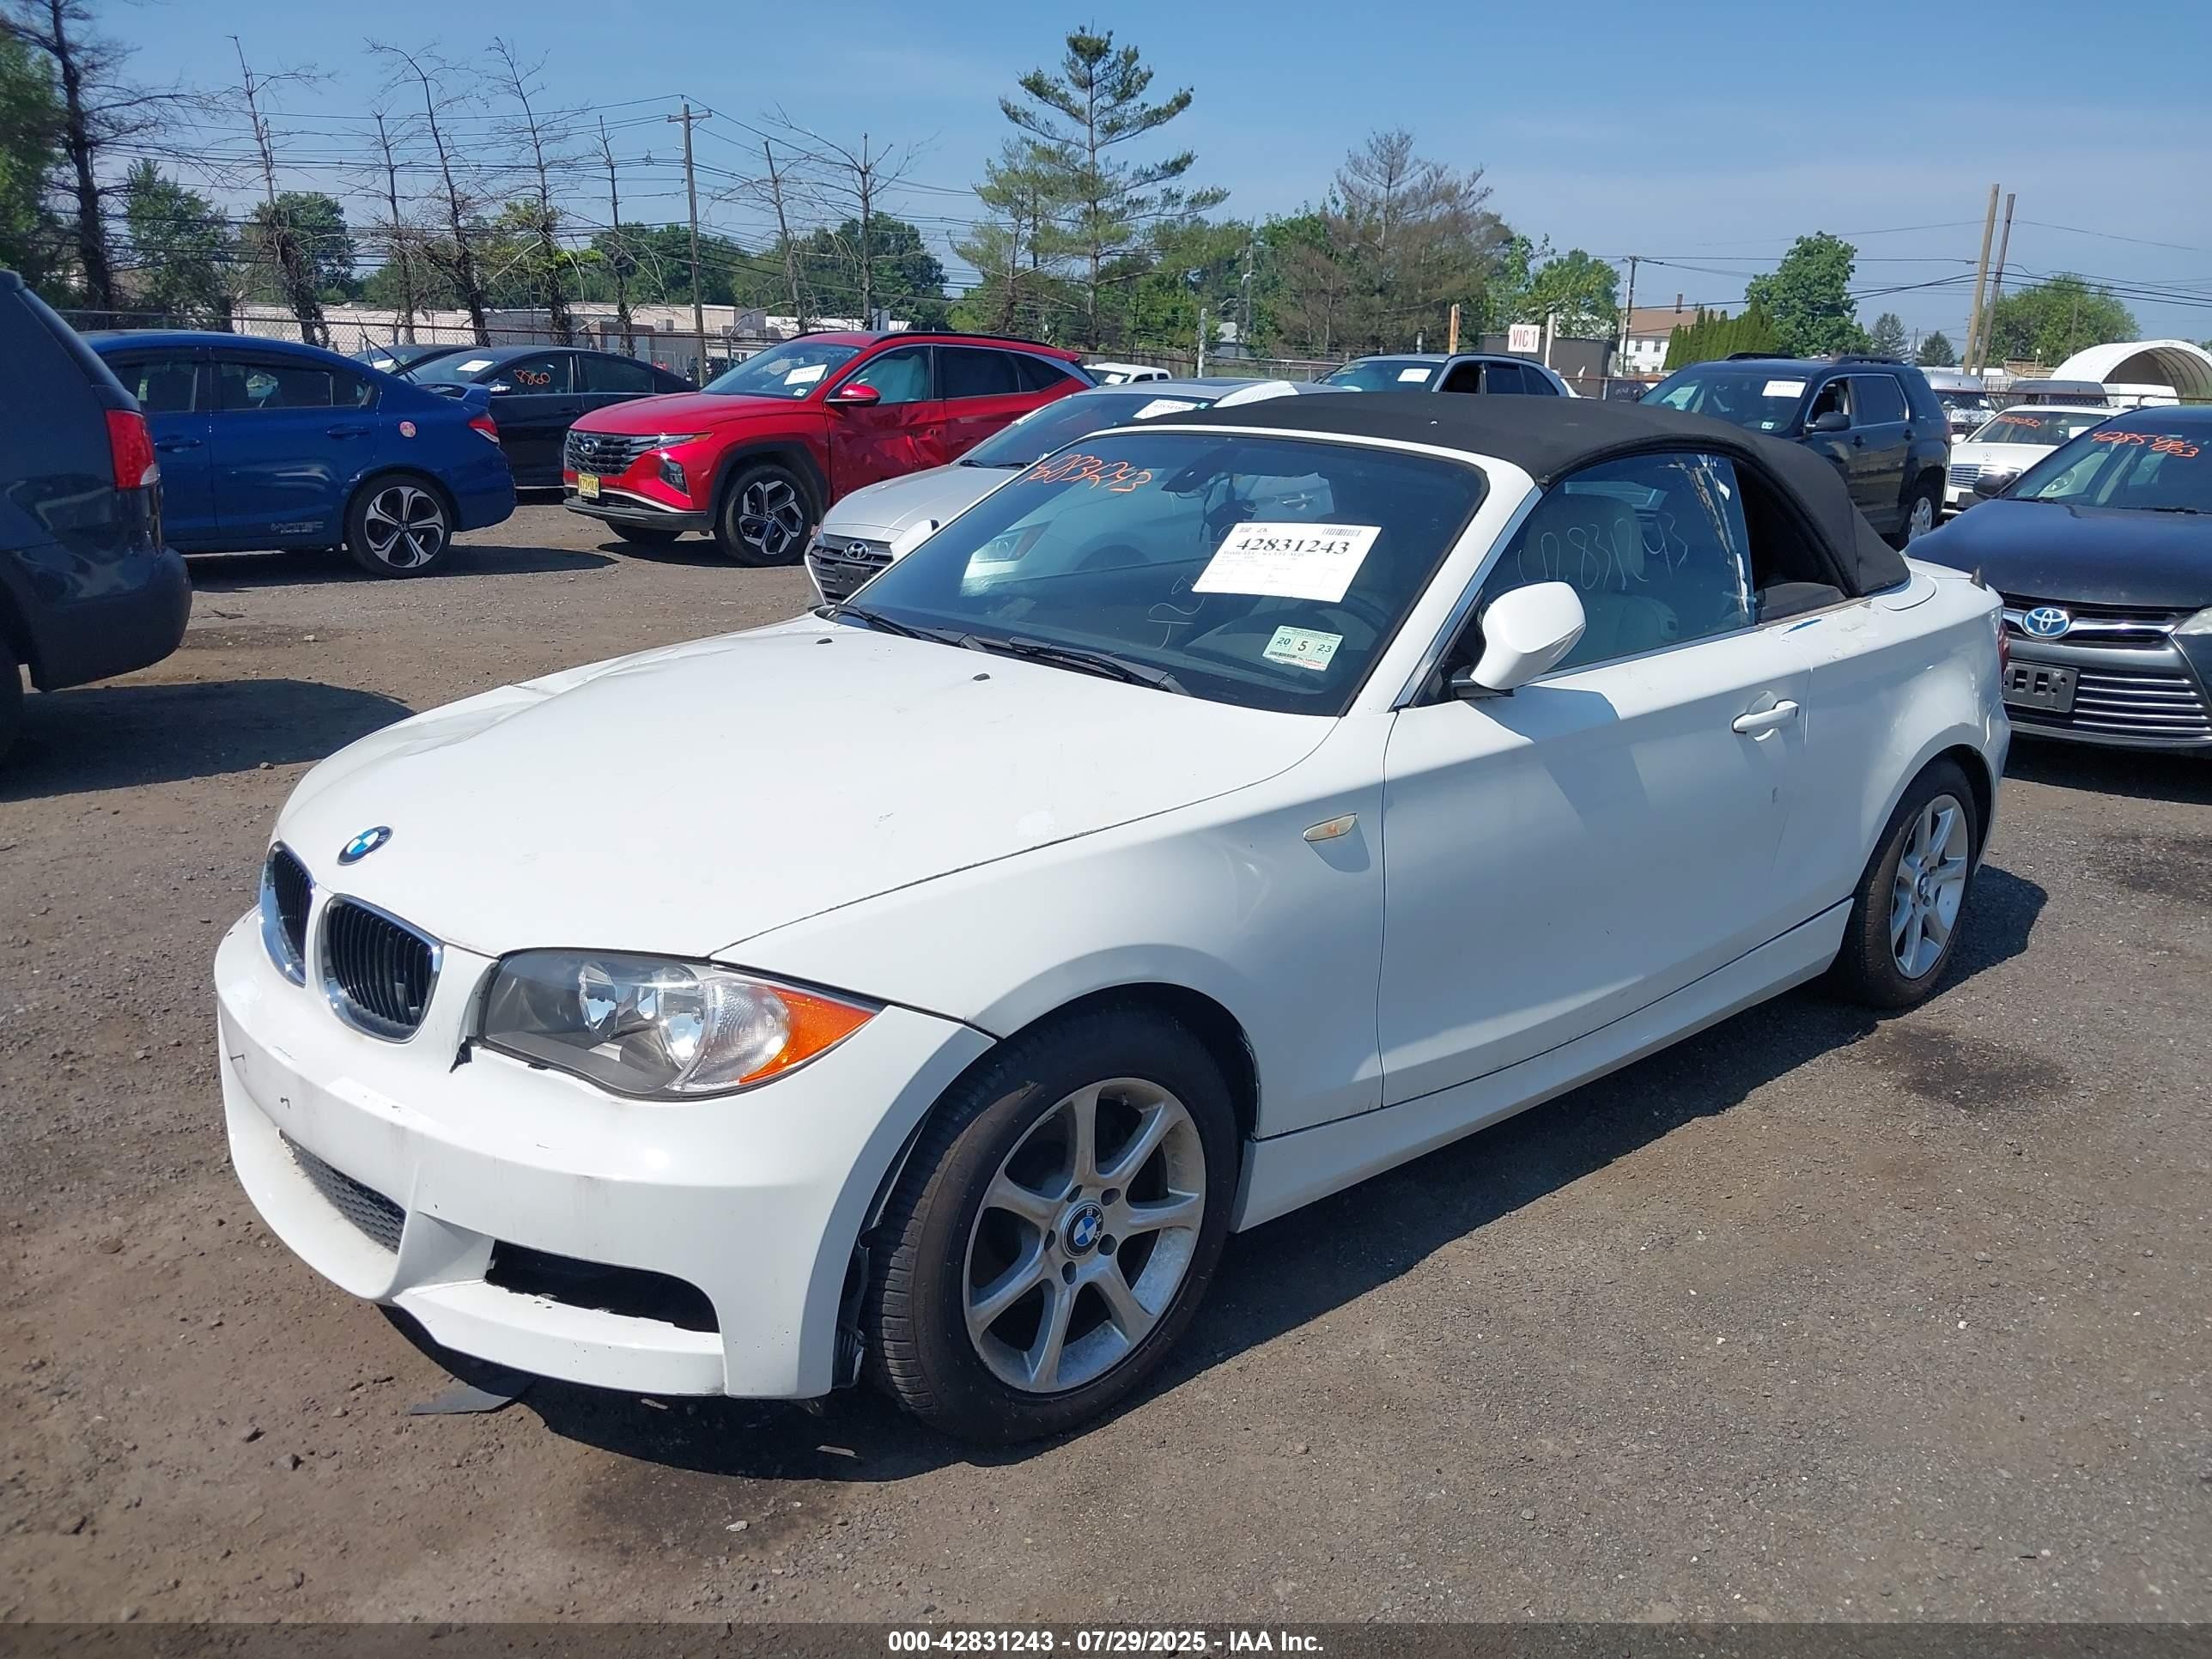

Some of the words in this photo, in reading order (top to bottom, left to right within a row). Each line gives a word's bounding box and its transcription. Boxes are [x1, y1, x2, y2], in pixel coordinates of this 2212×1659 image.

[1513, 330, 1528, 348] VIC
[1532, 331, 1536, 348] 1
[1237, 538, 1351, 555] 42831243
[1277, 636, 1291, 646] 20
[1297, 640, 1309, 652] 5
[1316, 644, 1332, 653] 23
